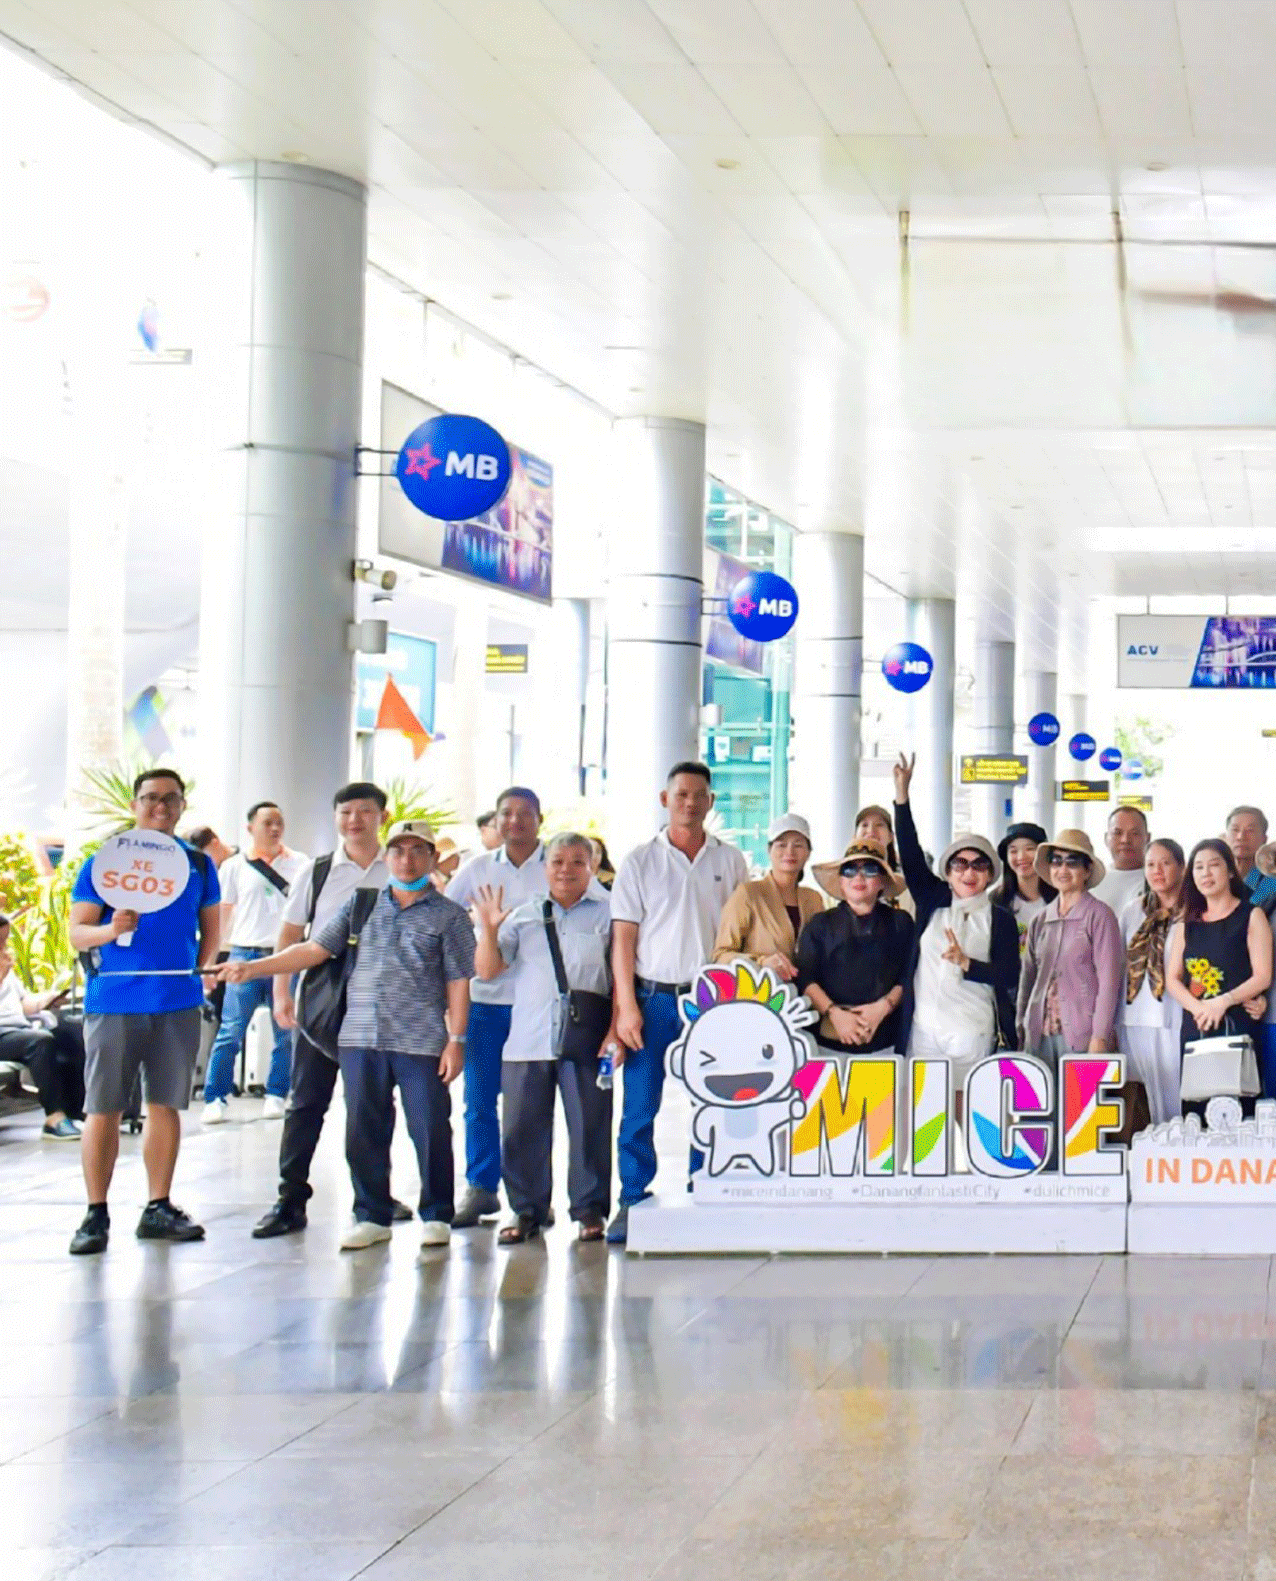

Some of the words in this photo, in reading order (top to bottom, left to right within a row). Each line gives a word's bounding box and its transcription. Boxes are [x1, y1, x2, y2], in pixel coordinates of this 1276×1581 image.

[445, 451, 498, 481] MB
[758, 598, 793, 617] MB
[1127, 645, 1159, 655] ACV
[904, 661, 929, 674] MB
[131, 860, 153, 873] XE
[788, 1057, 1126, 1178] MICE
[1145, 1158, 1181, 1184] IN
